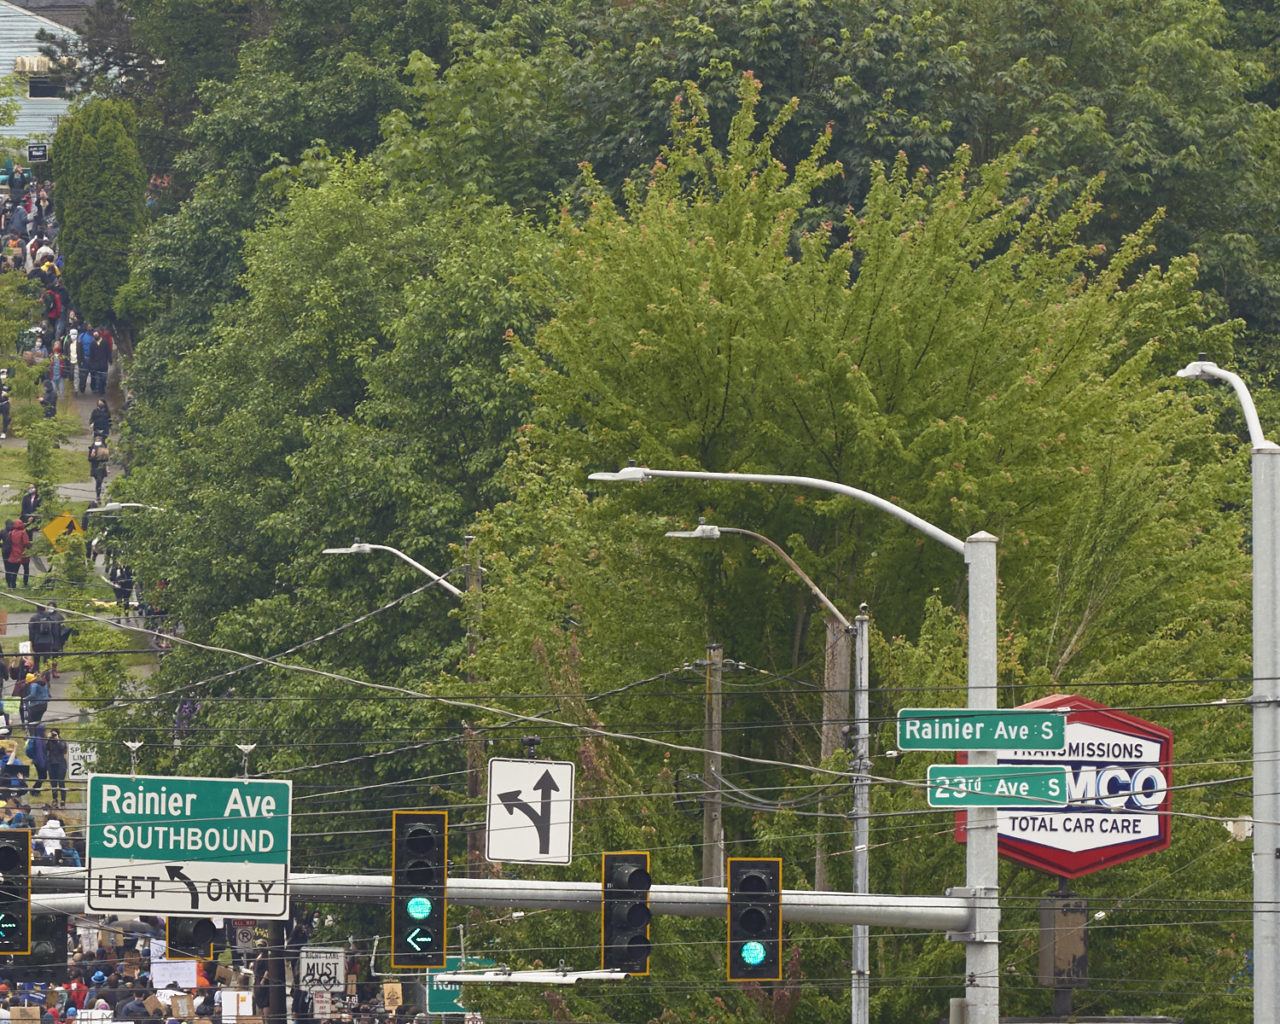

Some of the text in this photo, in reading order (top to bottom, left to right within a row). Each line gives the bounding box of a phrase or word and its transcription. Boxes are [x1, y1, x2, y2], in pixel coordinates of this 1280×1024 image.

[905, 718, 1053, 740] Rainier Ave S
[935, 776, 1061, 798] 23rd Ave S
[1066, 765, 1167, 810] MCO
[101, 784, 276, 818] Rainier Ave
[1010, 816, 1142, 834] TOTAL CAR CARE
[103, 825, 275, 853] SOUTHBOUND
[98, 874, 276, 903] LEFT ONLY
[306, 962, 339, 977] MUST
